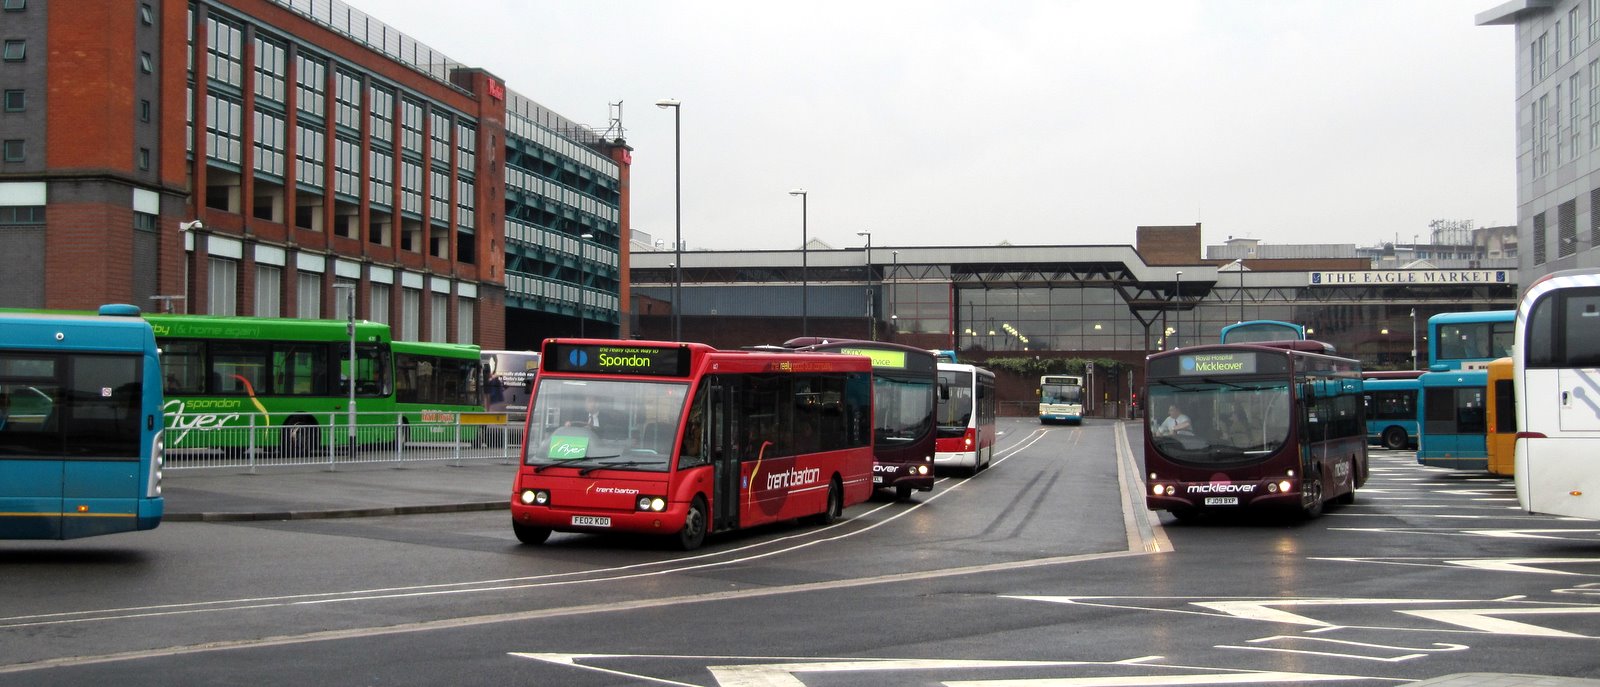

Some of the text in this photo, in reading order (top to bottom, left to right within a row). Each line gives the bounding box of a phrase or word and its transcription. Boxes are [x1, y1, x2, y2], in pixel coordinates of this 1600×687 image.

[1326, 271, 1491, 283] THE EAGLE MARKET
[152, 323, 170, 335] by
[188, 324, 221, 335] home
[599, 353, 651, 367] Spondon
[1195, 361, 1243, 372] Mickleover
[186, 399, 240, 410] spondon
[767, 466, 820, 490] trent barton
[596, 486, 640, 495] trent barton
[1187, 483, 1257, 493] mickleover
[574, 516, 594, 525] FE02
